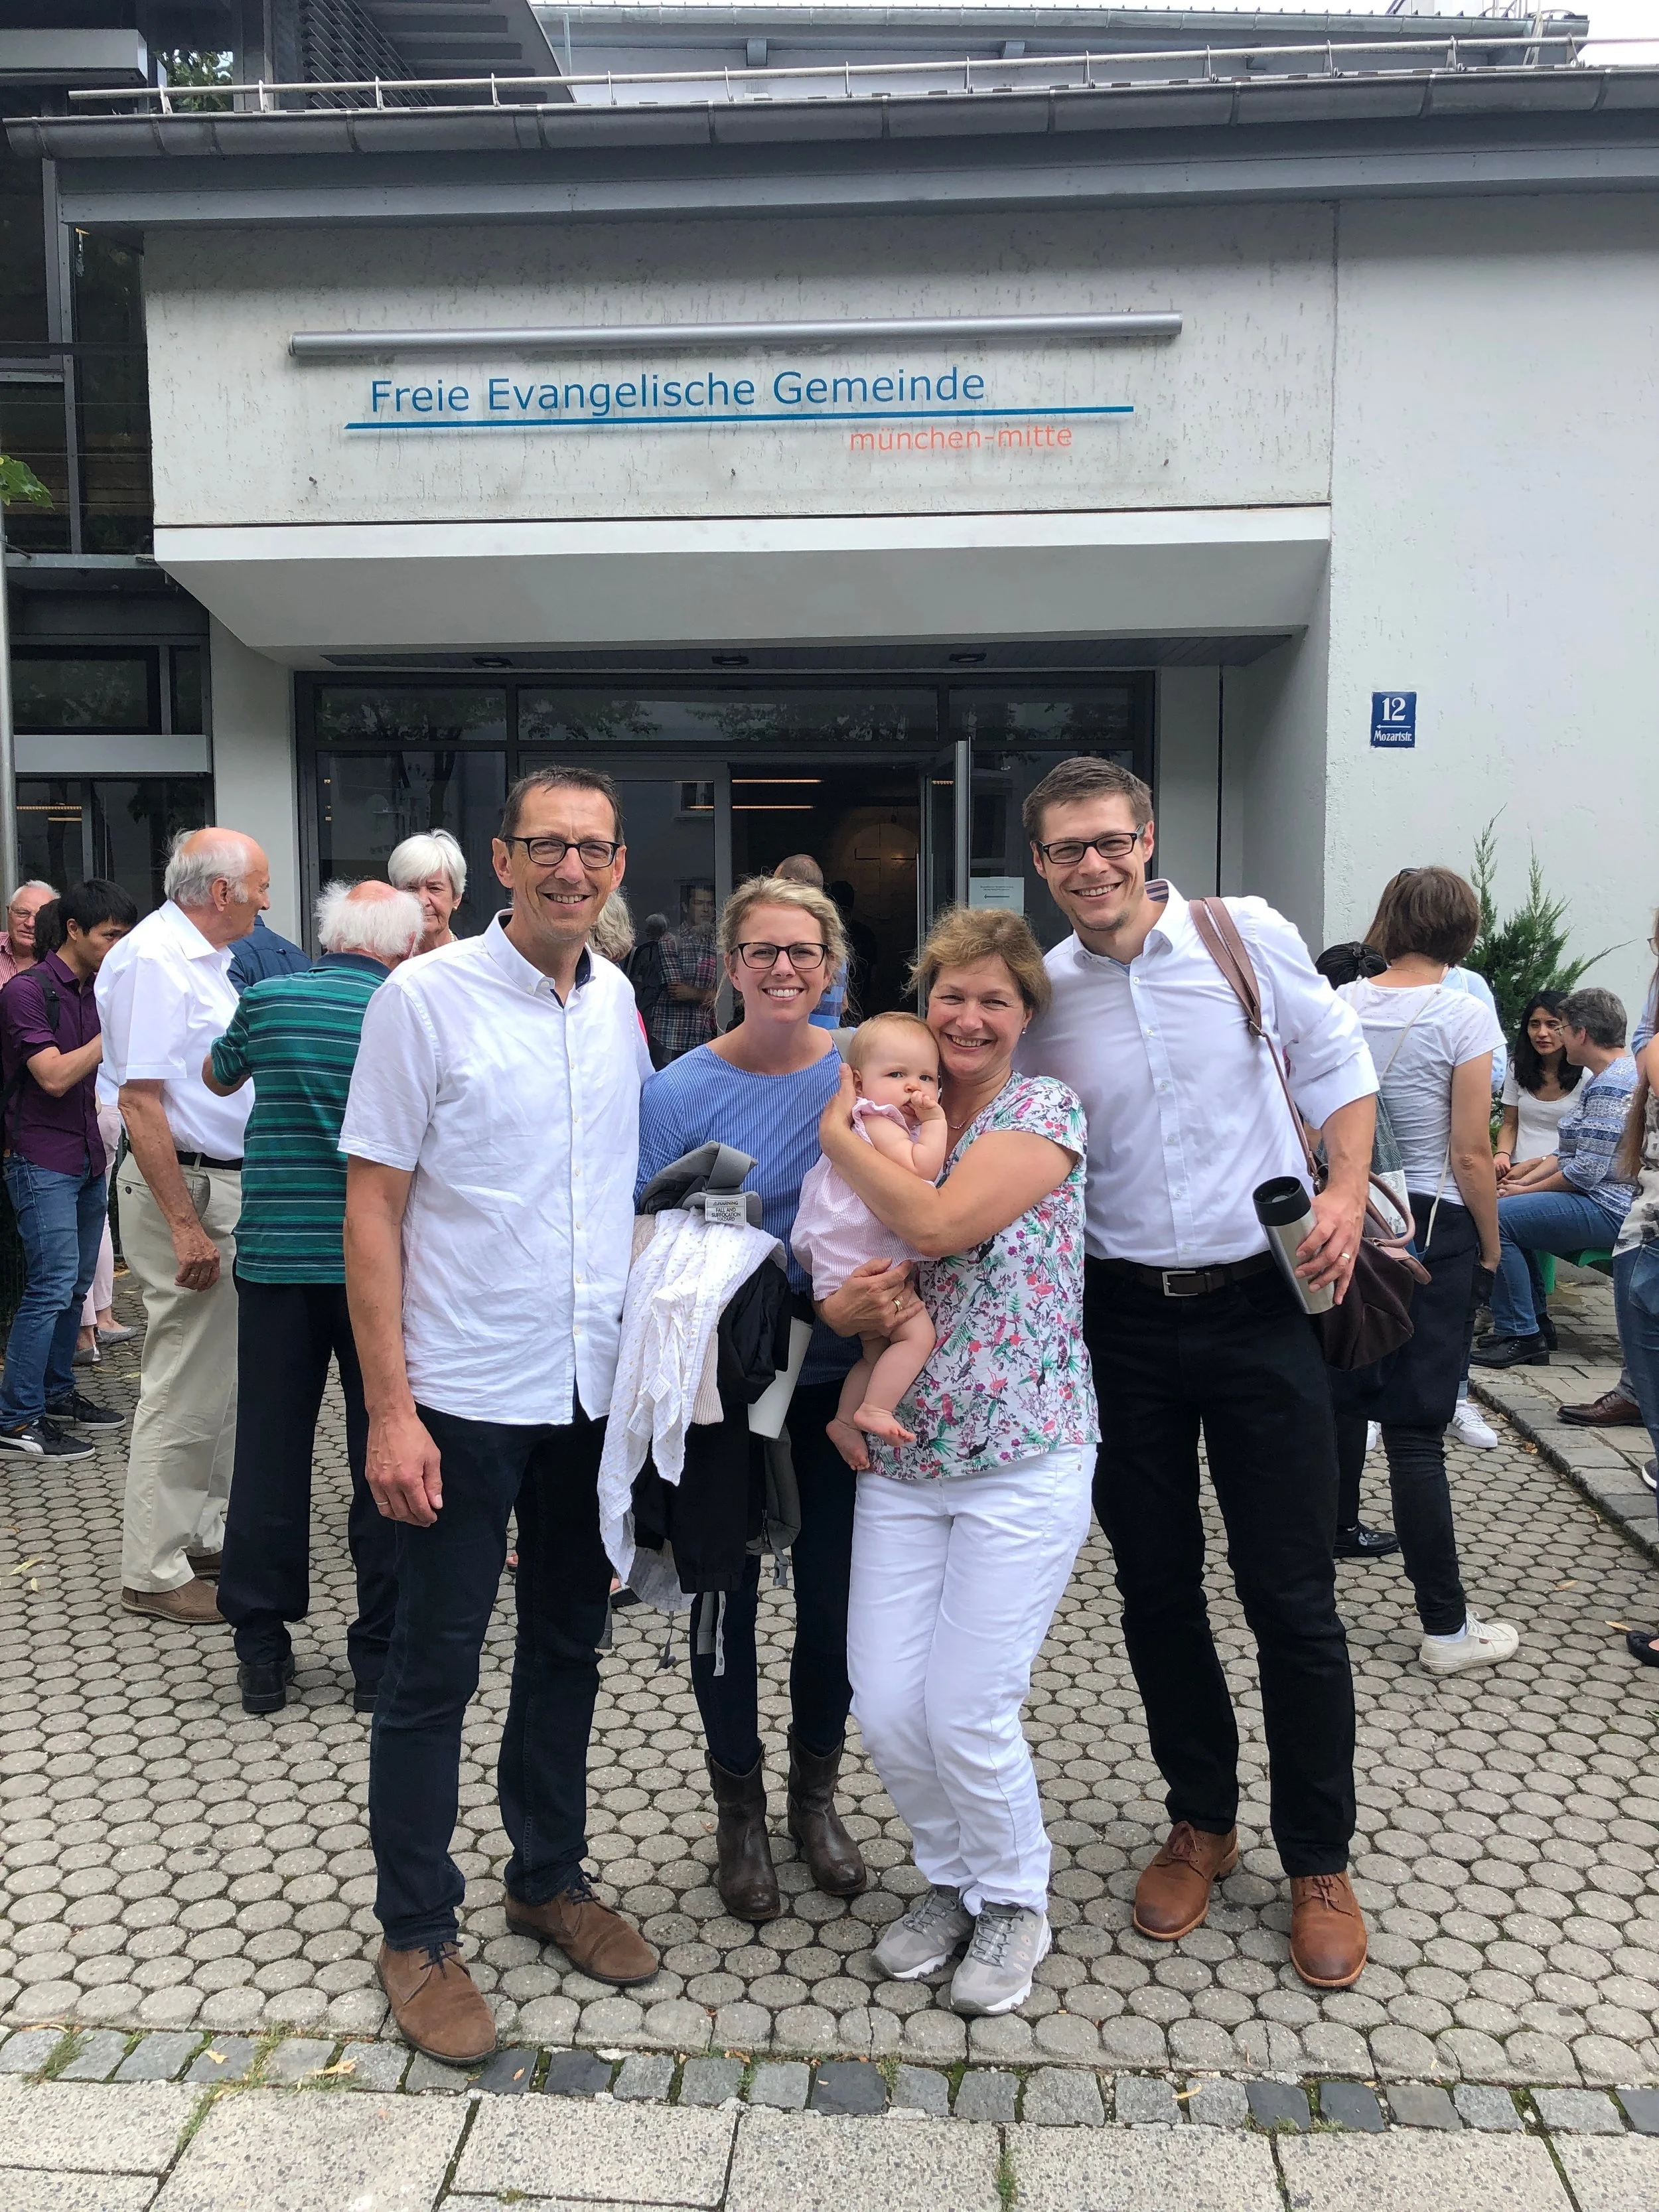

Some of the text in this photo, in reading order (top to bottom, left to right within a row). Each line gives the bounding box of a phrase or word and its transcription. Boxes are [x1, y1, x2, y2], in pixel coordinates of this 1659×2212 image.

[372, 366, 984, 416] Freie Evangelische Gemeinde
[850, 425, 1072, 451] münchen-mitte
[1382, 697, 1406, 721] 12
[1373, 730, 1412, 741] Mozartstr.
